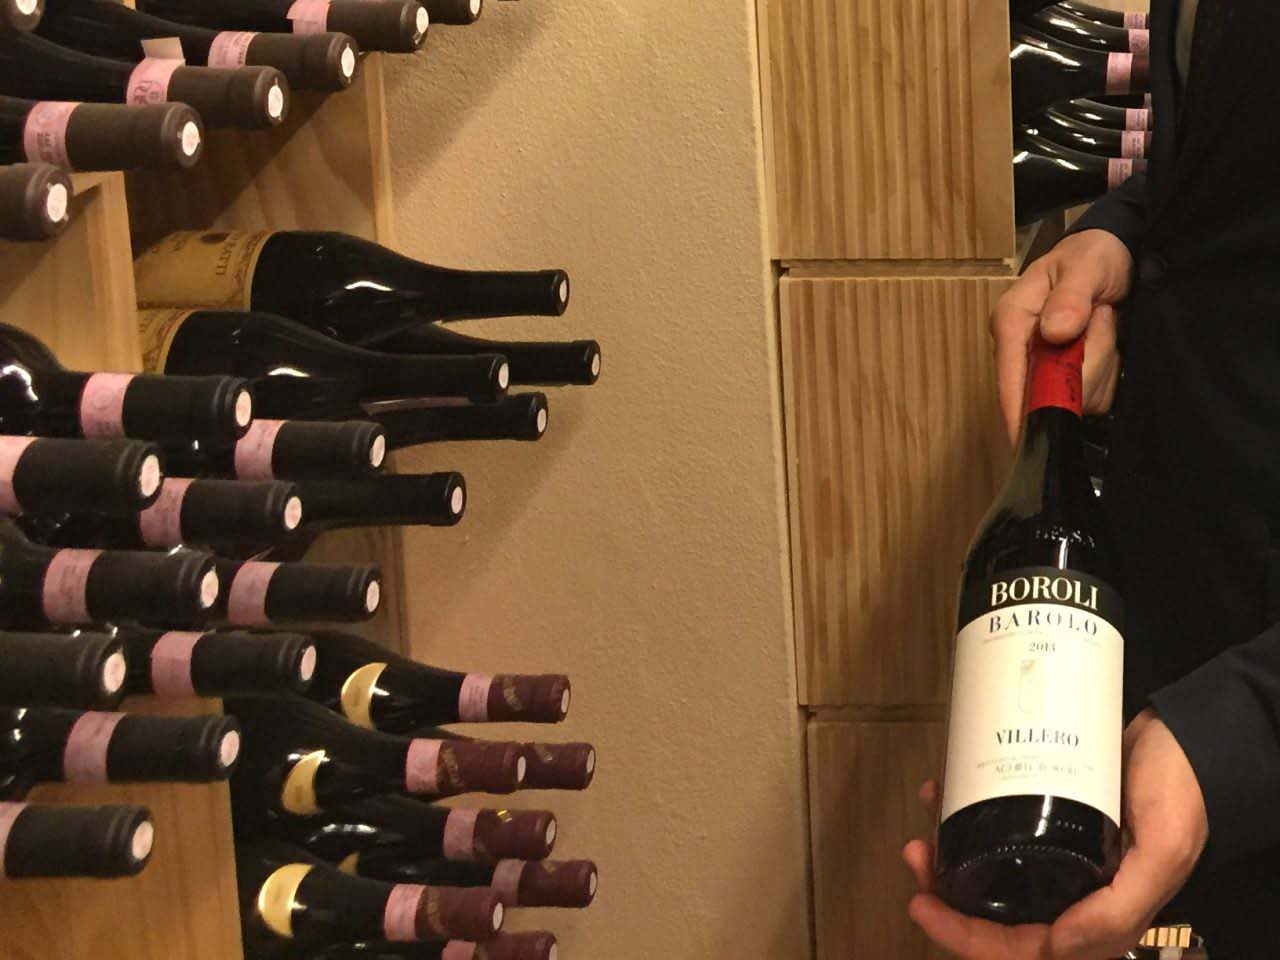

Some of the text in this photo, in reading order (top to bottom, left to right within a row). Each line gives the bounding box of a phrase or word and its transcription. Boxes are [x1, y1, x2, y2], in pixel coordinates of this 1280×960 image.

[991, 576, 1099, 611] BOROLI
[989, 610, 1098, 636] BAROLO
[995, 728, 1080, 747] VILLERO
